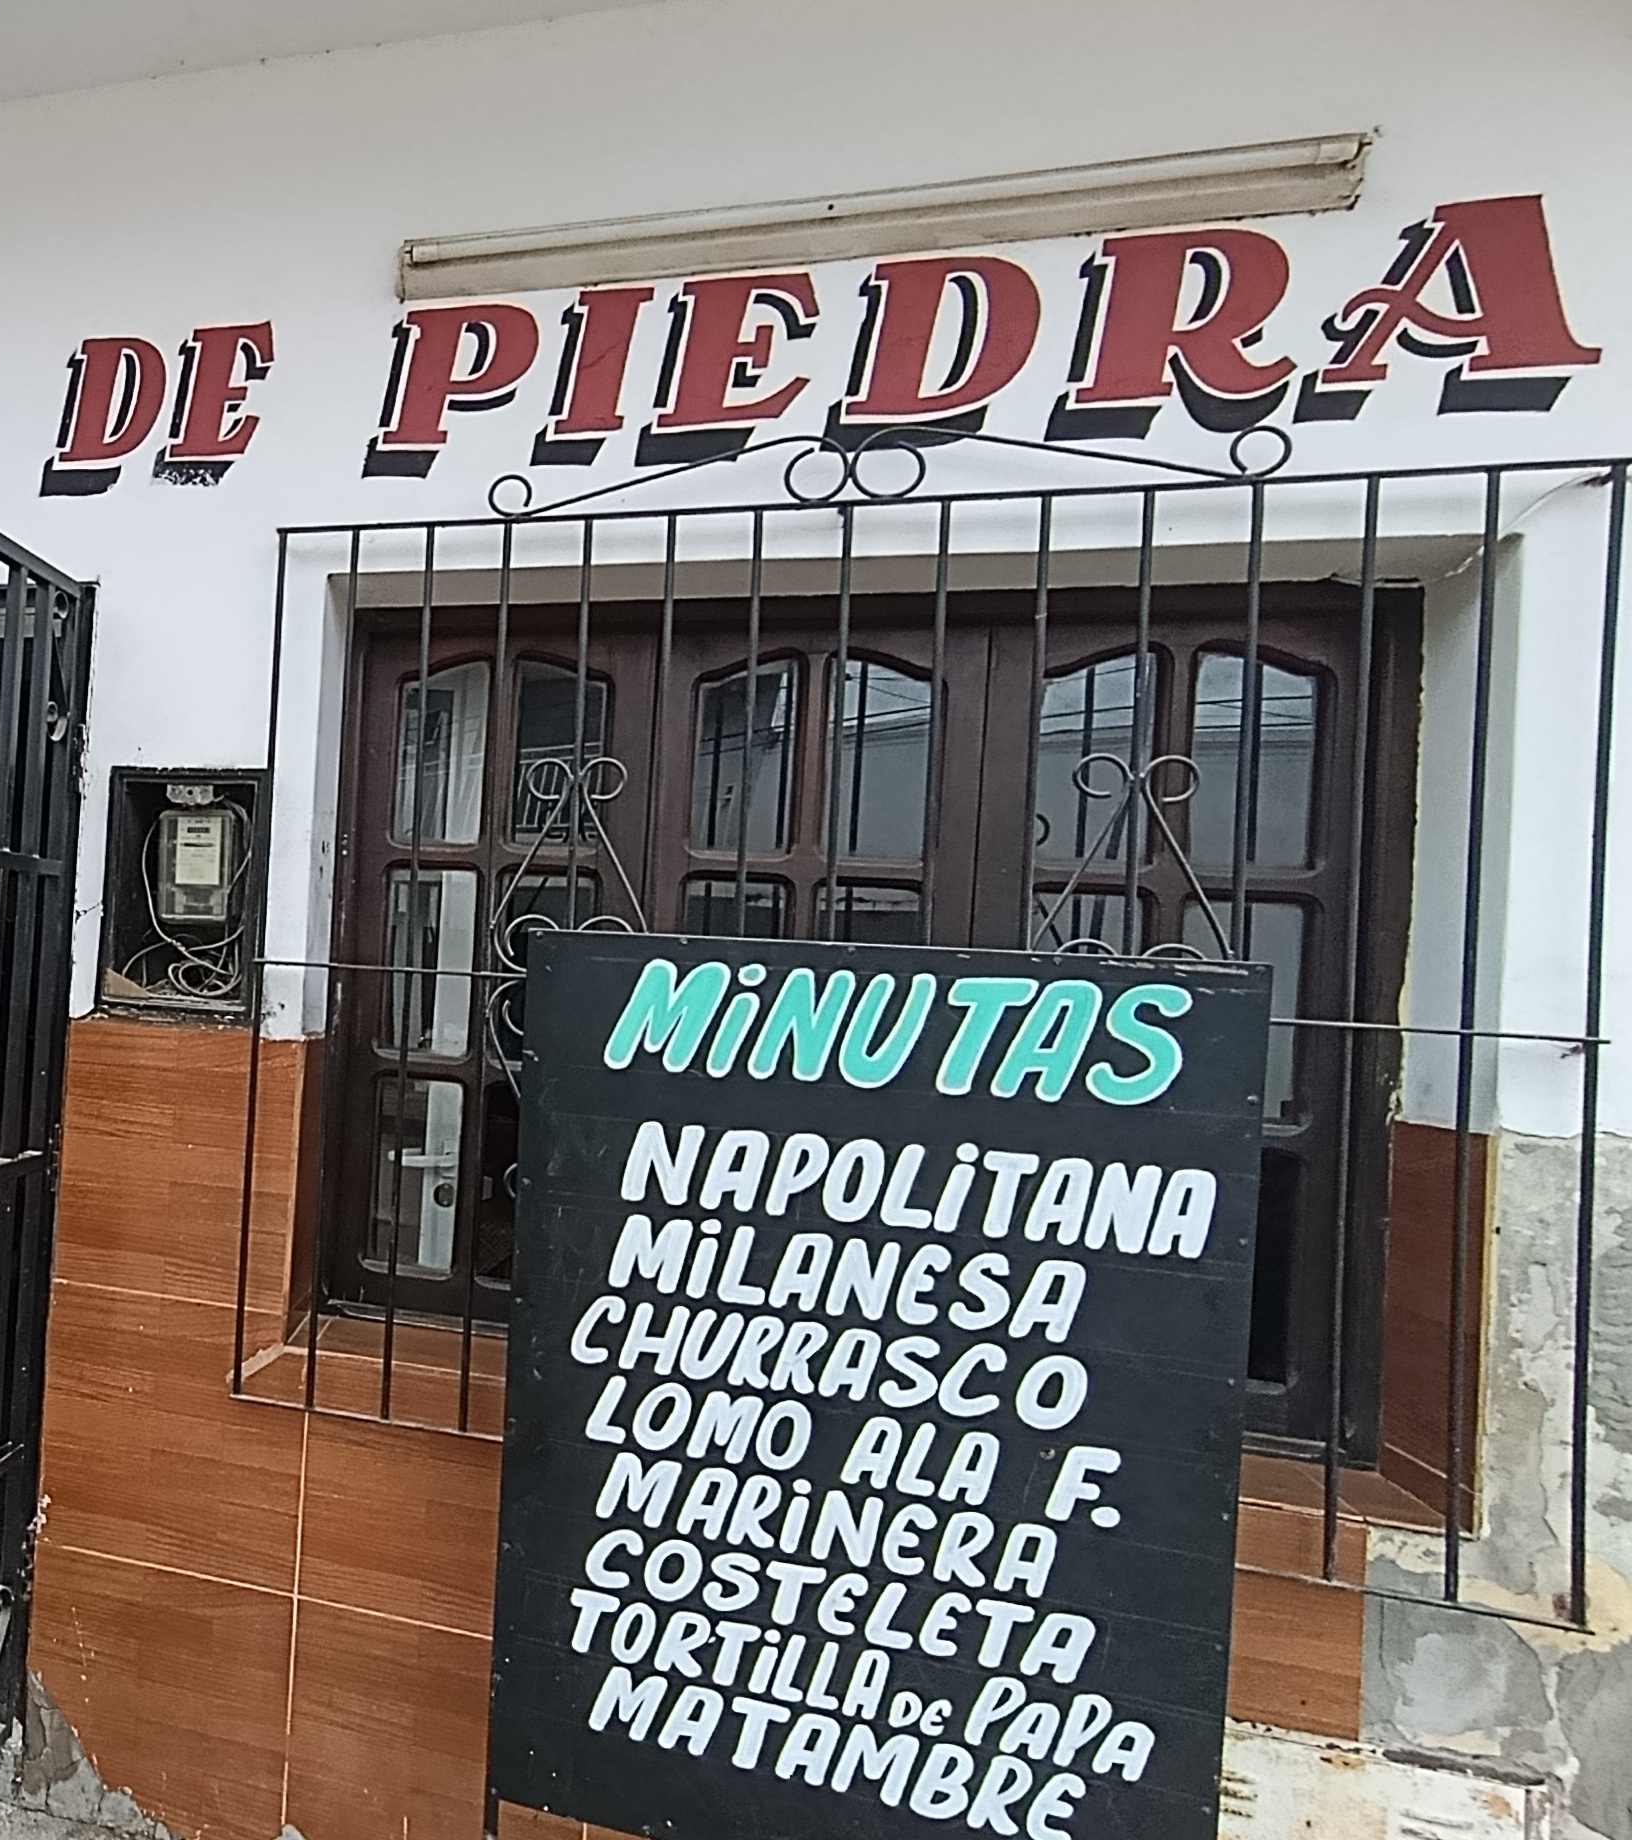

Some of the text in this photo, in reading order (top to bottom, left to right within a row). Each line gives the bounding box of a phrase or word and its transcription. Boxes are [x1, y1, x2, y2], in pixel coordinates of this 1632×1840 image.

[39, 320, 274, 496] DE
[361, 194, 1602, 480] PIEDRA
[570, 1295, 1089, 1430] CHURRASCO
[585, 1375, 1122, 1529] LOMO ALA F.
[585, 1528, 1097, 1684] COSTELETA
[588, 1665, 1088, 1840] MATAMBRE
[964, 1676, 1156, 1782] PAPA
